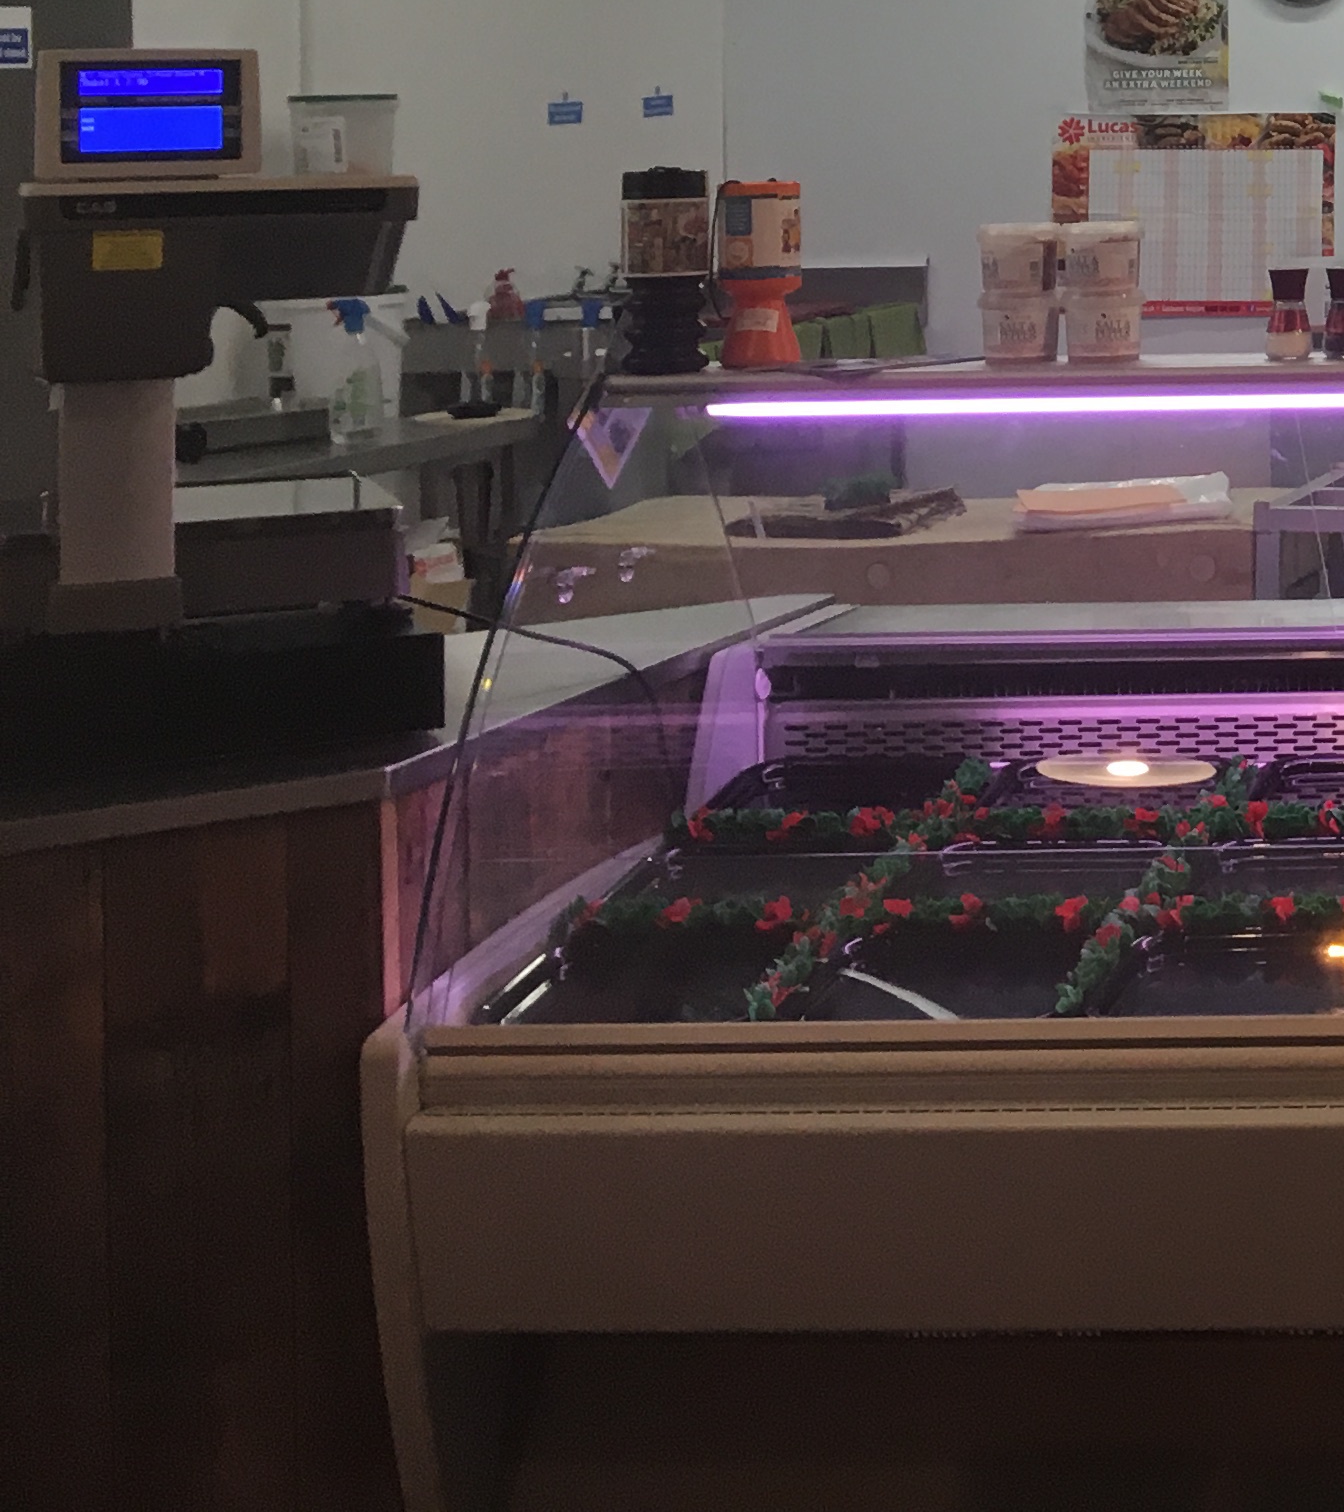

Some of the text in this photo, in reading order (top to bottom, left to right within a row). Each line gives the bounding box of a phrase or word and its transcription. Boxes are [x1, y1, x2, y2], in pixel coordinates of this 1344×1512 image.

[1113, 69, 1203, 79] GIVE YOUR WEEK
[1160, 79, 1213, 88] WEEKEND
[1087, 119, 1139, 135] Lucas
